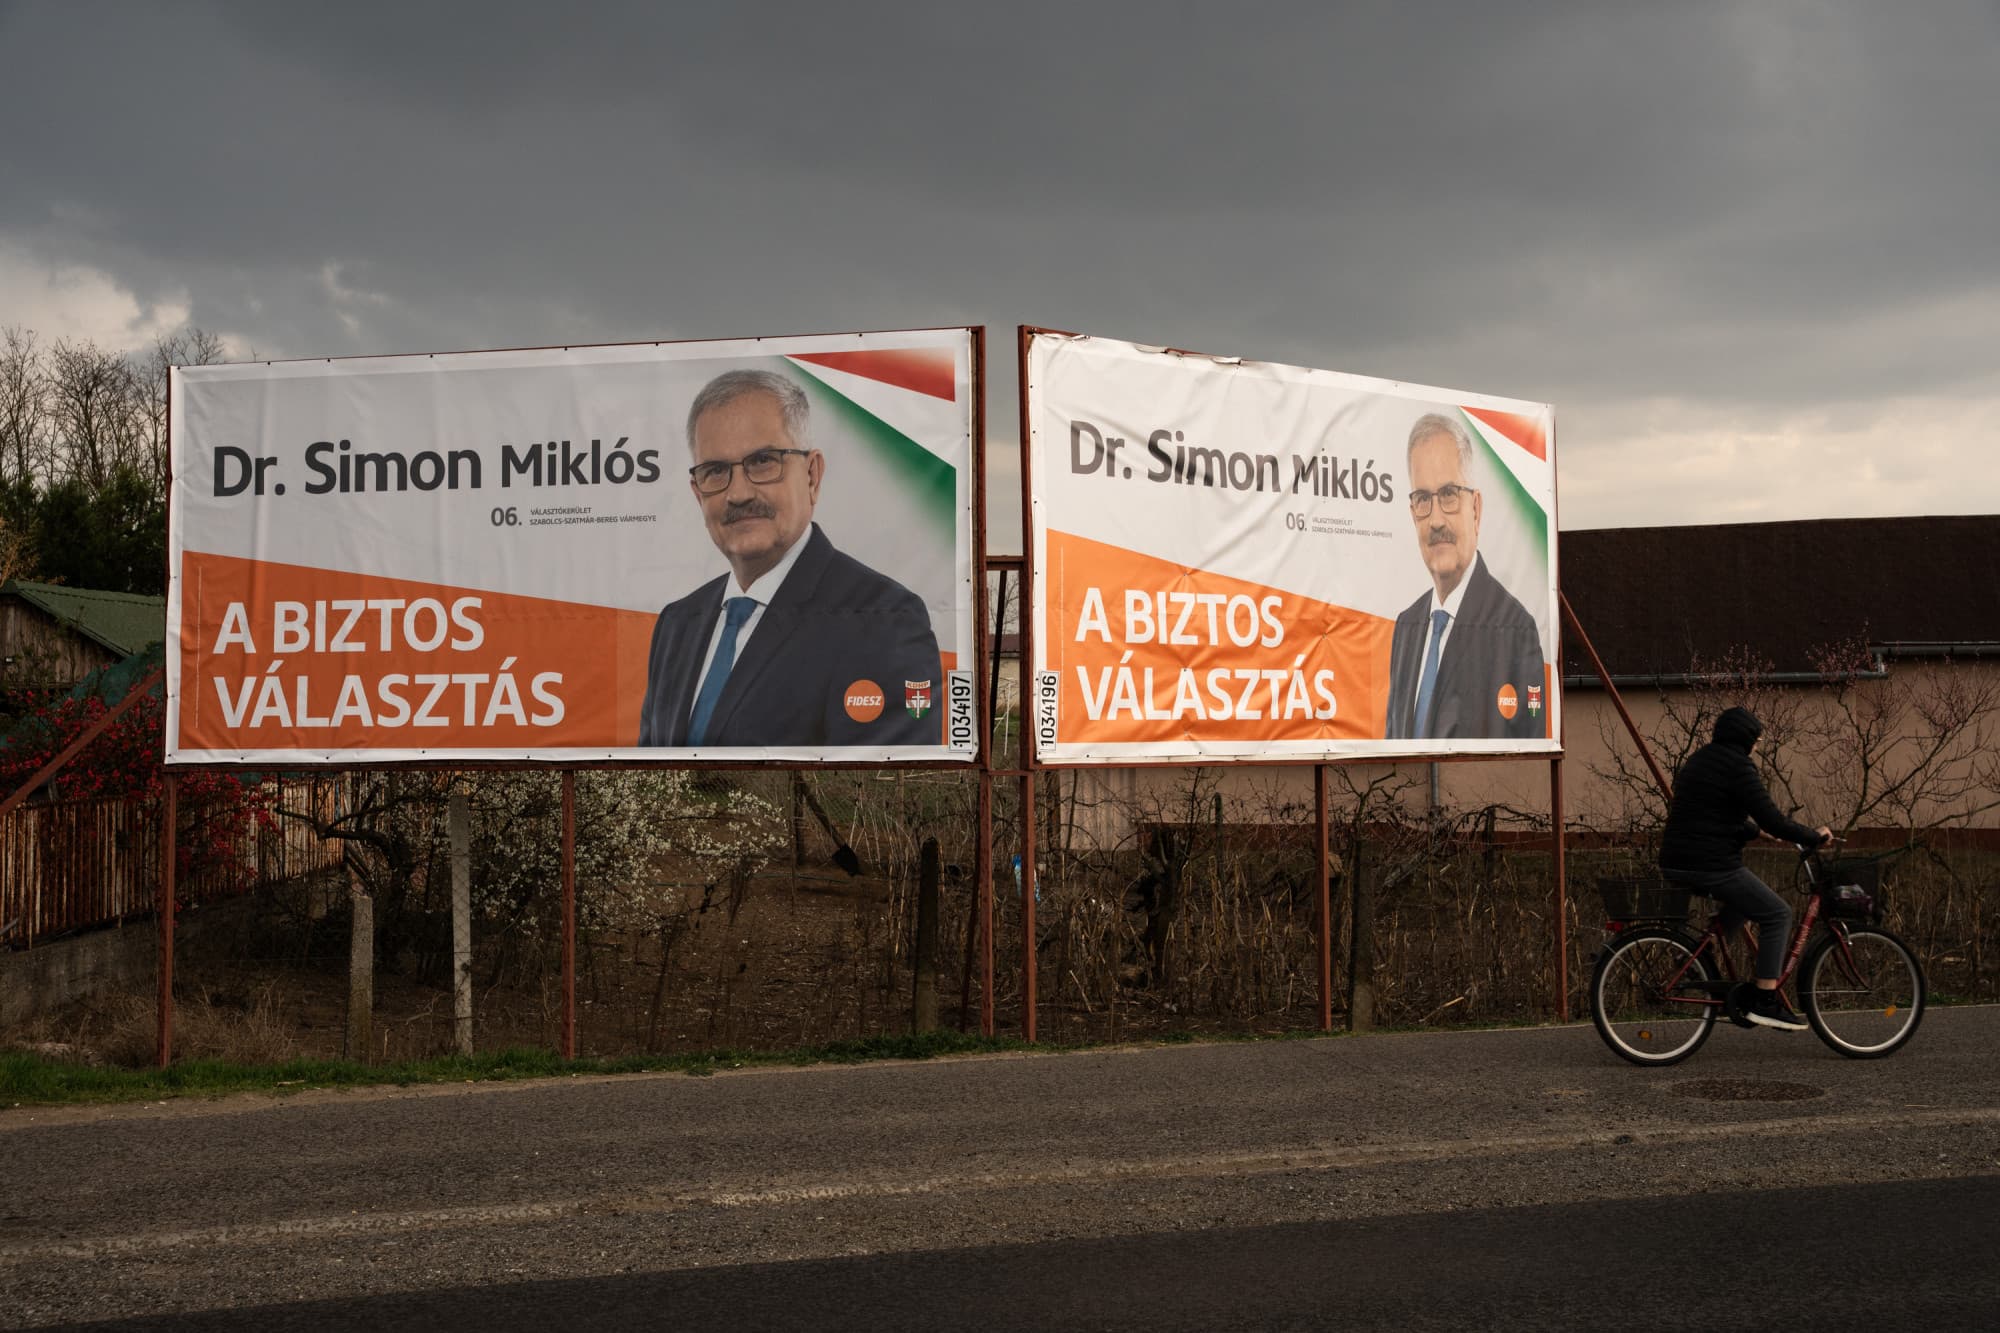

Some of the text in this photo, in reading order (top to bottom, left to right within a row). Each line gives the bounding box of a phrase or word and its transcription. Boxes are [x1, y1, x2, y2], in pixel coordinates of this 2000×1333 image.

[213, 437, 661, 498] Dr. Simon Miklós
[1070, 420, 1394, 503] Dr. Simon Miklós
[490, 506, 522, 527] 06.
[530, 507, 592, 515] VÁLASZTÓKERÜLET
[620, 515, 657, 523] VÁRMEGYE
[1285, 512, 1308, 532] 06.
[212, 597, 485, 654] A BIZTOS
[1075, 587, 1285, 649] A BIZTOS
[212, 656, 566, 728] VÁLASZTÁS
[846, 695, 882, 707] FIDESZ
[951, 675, 971, 746] 1034197
[1040, 675, 1057, 747] 1034196
[1075, 651, 1338, 721] VÁLASZTÁS
